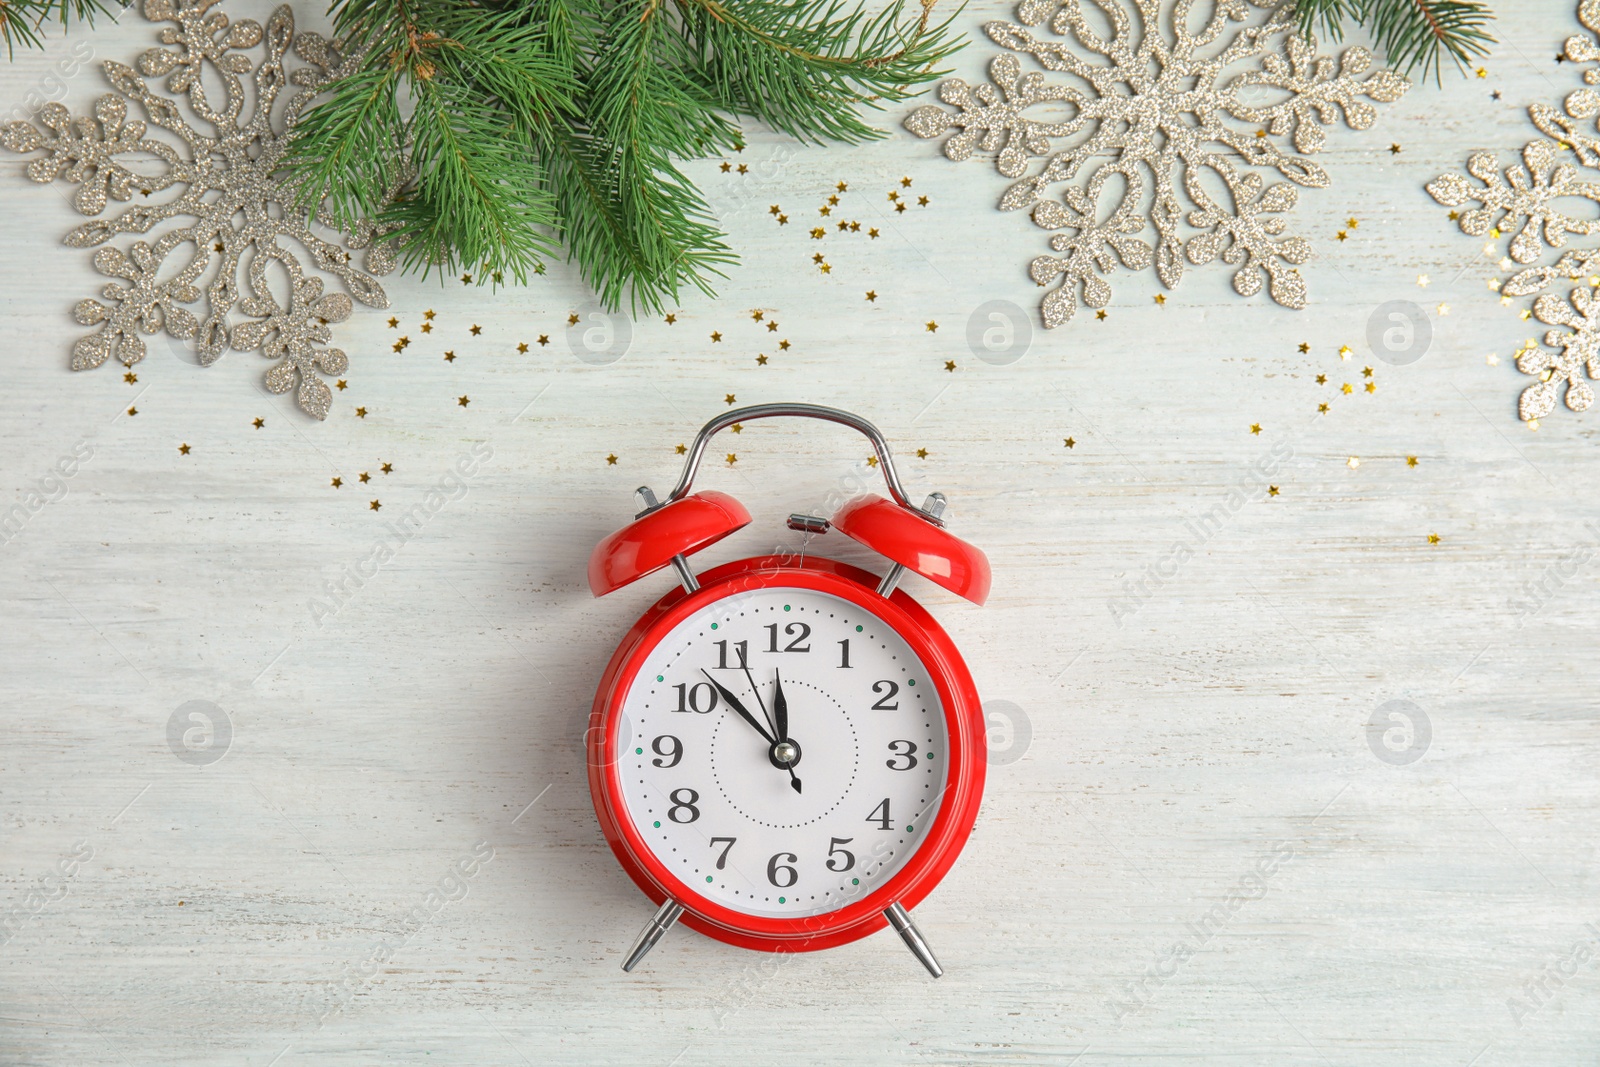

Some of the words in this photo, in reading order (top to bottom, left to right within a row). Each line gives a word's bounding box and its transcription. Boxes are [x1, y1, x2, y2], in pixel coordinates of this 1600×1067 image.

[764, 623, 810, 652] 12
[837, 639, 853, 668] 1
[712, 639, 754, 670] 11
[671, 682, 718, 714] 10
[871, 680, 899, 710] 2
[652, 735, 683, 768] 9
[886, 740, 917, 771] 3
[668, 788, 700, 823] 8
[866, 798, 894, 830] 4
[710, 837, 736, 869] 7
[826, 837, 855, 872] 5
[767, 853, 798, 887] 6
